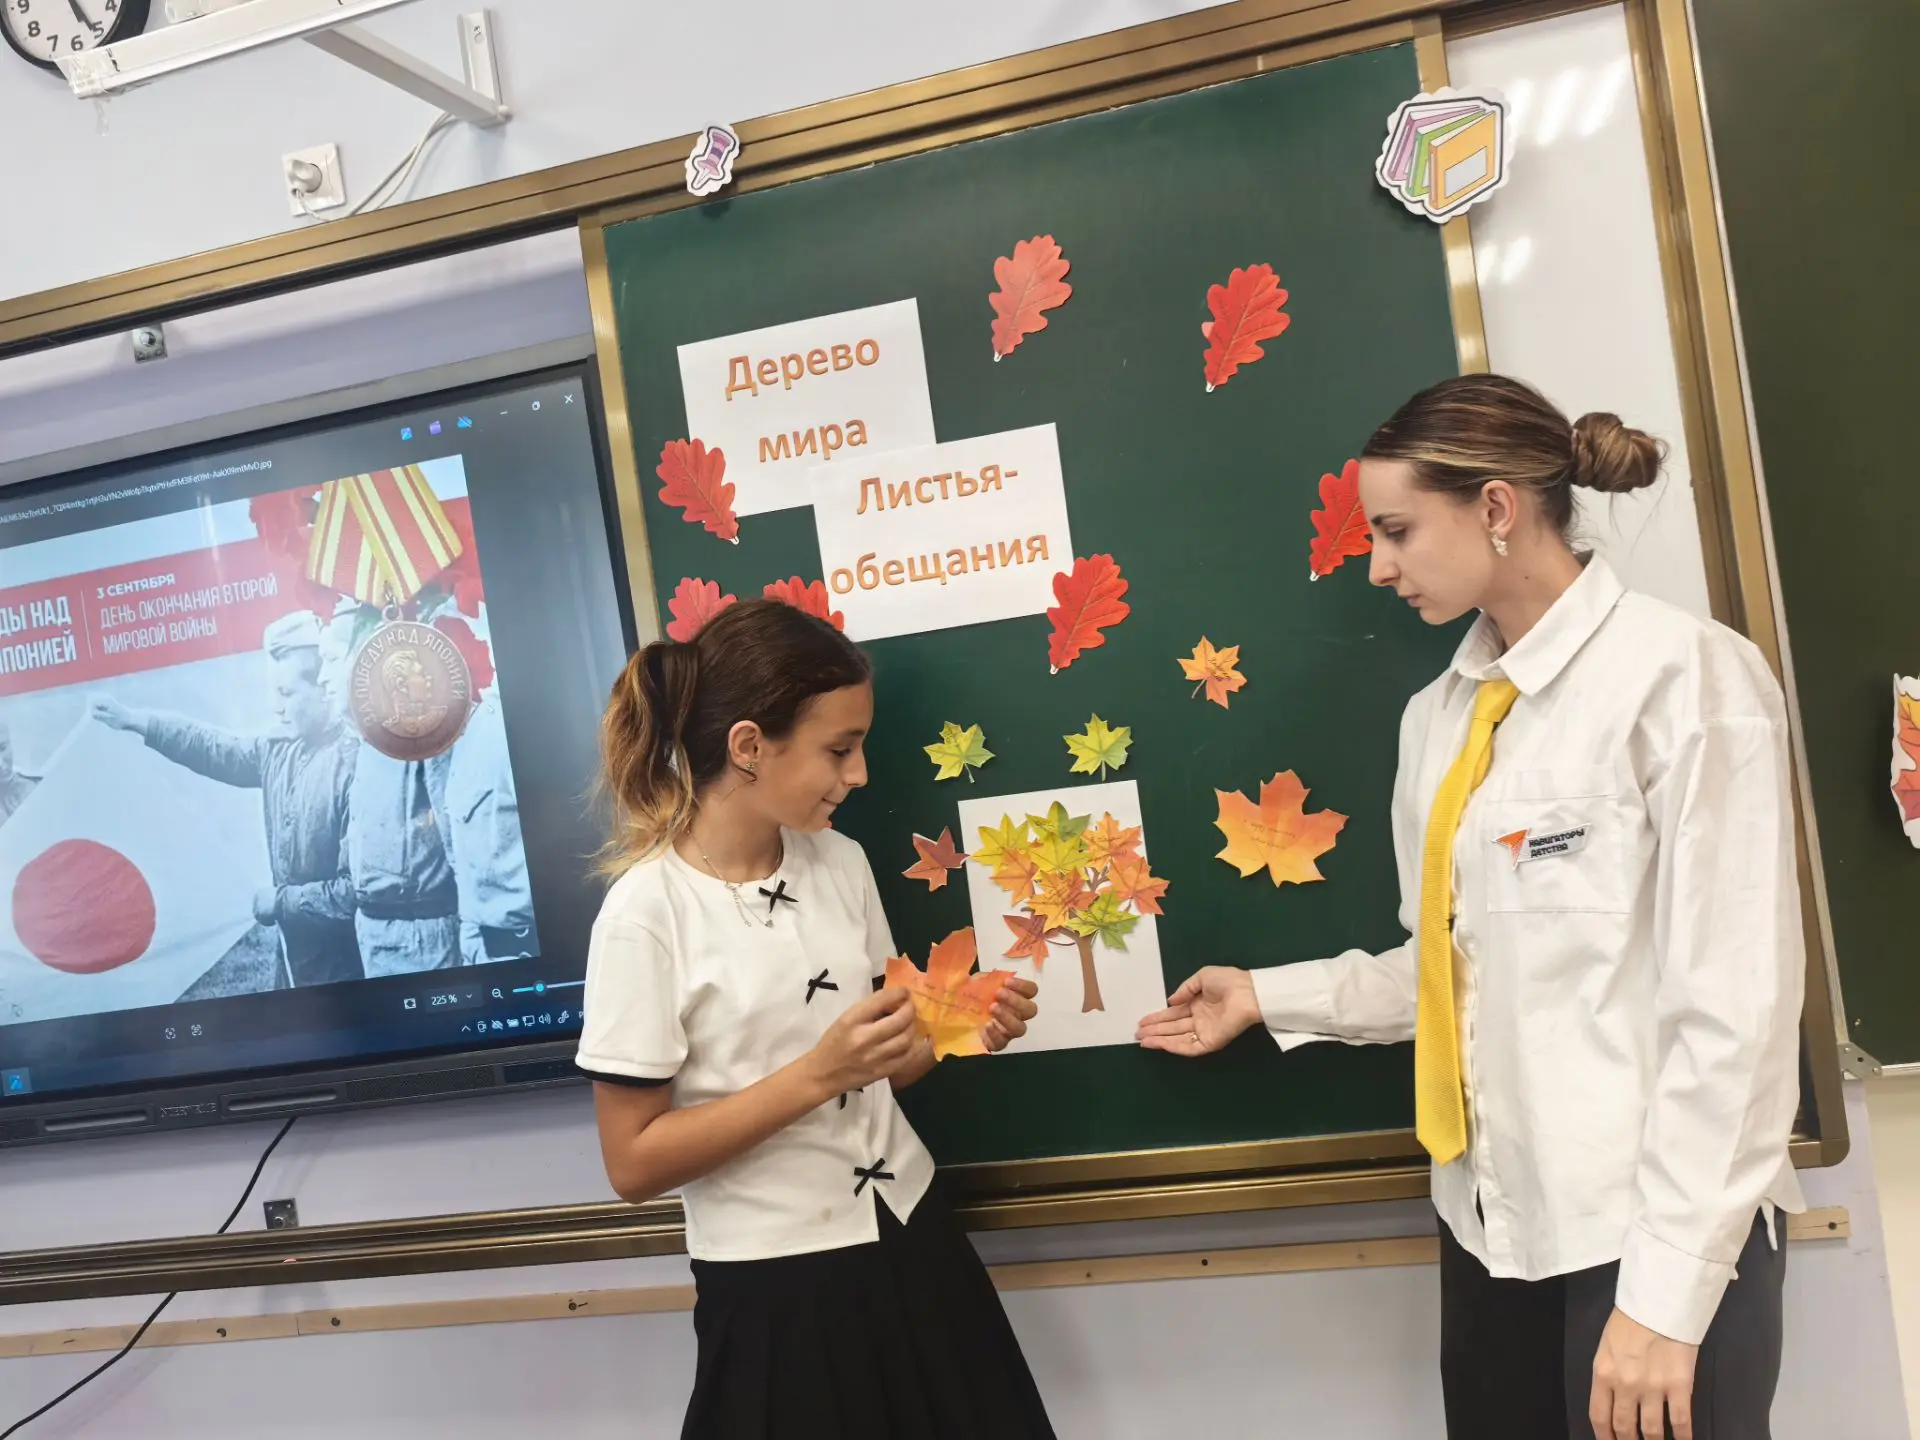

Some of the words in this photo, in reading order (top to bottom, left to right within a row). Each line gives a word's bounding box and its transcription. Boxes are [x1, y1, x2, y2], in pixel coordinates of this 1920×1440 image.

[18, 0, 30, 14] 9
[105, 0, 117, 13] 4
[27, 20, 41, 38] 8
[92, 21, 105, 39] 5
[46, 34, 58, 52] 7
[70, 35, 84, 51] 6
[724, 337, 880, 401] Дерево
[758, 417, 868, 463] мира
[856, 463, 1018, 515] Листья-
[830, 534, 1050, 594] обещания
[96, 587, 105, 600] 3
[107, 573, 176, 598] СЕНТЯБРЯ
[29, 596, 72, 628] НАД
[100, 602, 136, 630] ДЕНЬ
[138, 586, 221, 620] ОКОНЧАНИЯ
[223, 573, 279, 605] ВТОРОЙ
[102, 622, 167, 655] МИРОВОЙ
[169, 616, 218, 641] ВОЙНЫ
[355, 638, 385, 700] ПОБЕДУ
[385, 628, 419, 646] НАД
[423, 632, 466, 700] ЯПОНИЕЙ
[1529, 829, 1585, 848] НАВИГАТОРЫ
[431, 995, 447, 1006] 225
[448, 994, 458, 1004] %
